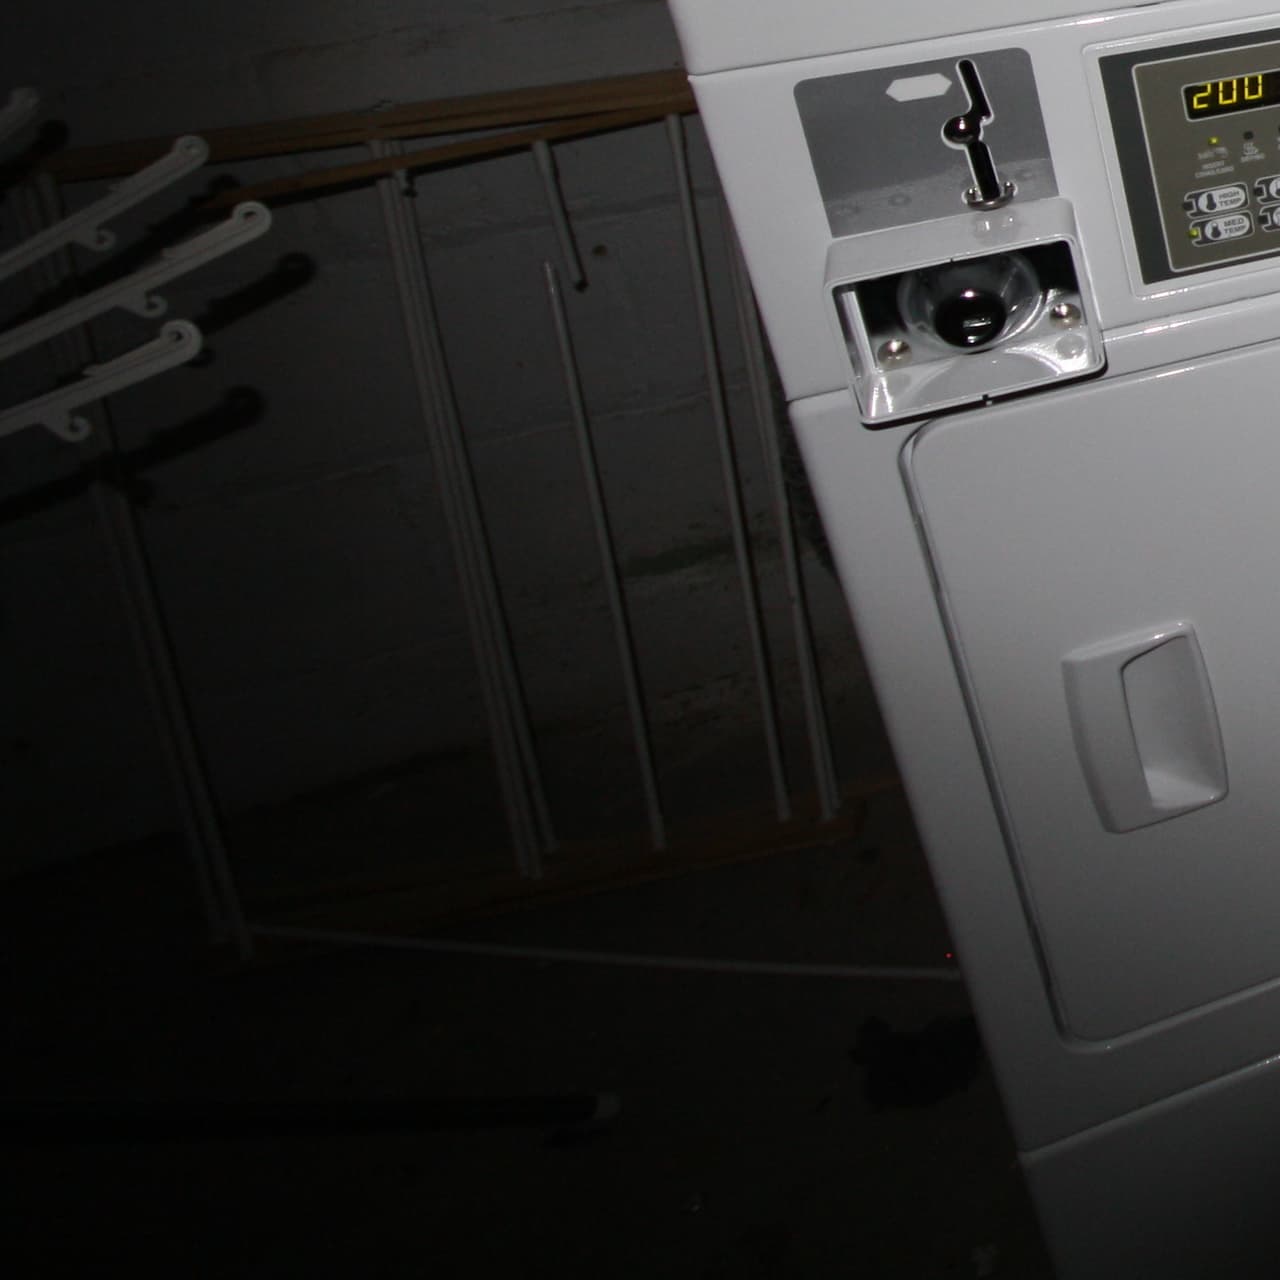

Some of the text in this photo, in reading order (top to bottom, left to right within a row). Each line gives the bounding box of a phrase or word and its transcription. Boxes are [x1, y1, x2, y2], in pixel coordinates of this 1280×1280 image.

[1193, 74, 1263, 109] 200
[1219, 190, 1240, 199] HIGH
[1220, 197, 1241, 207] TEMP
[1224, 218, 1245, 227] MED
[1225, 225, 1246, 234] TEMP
